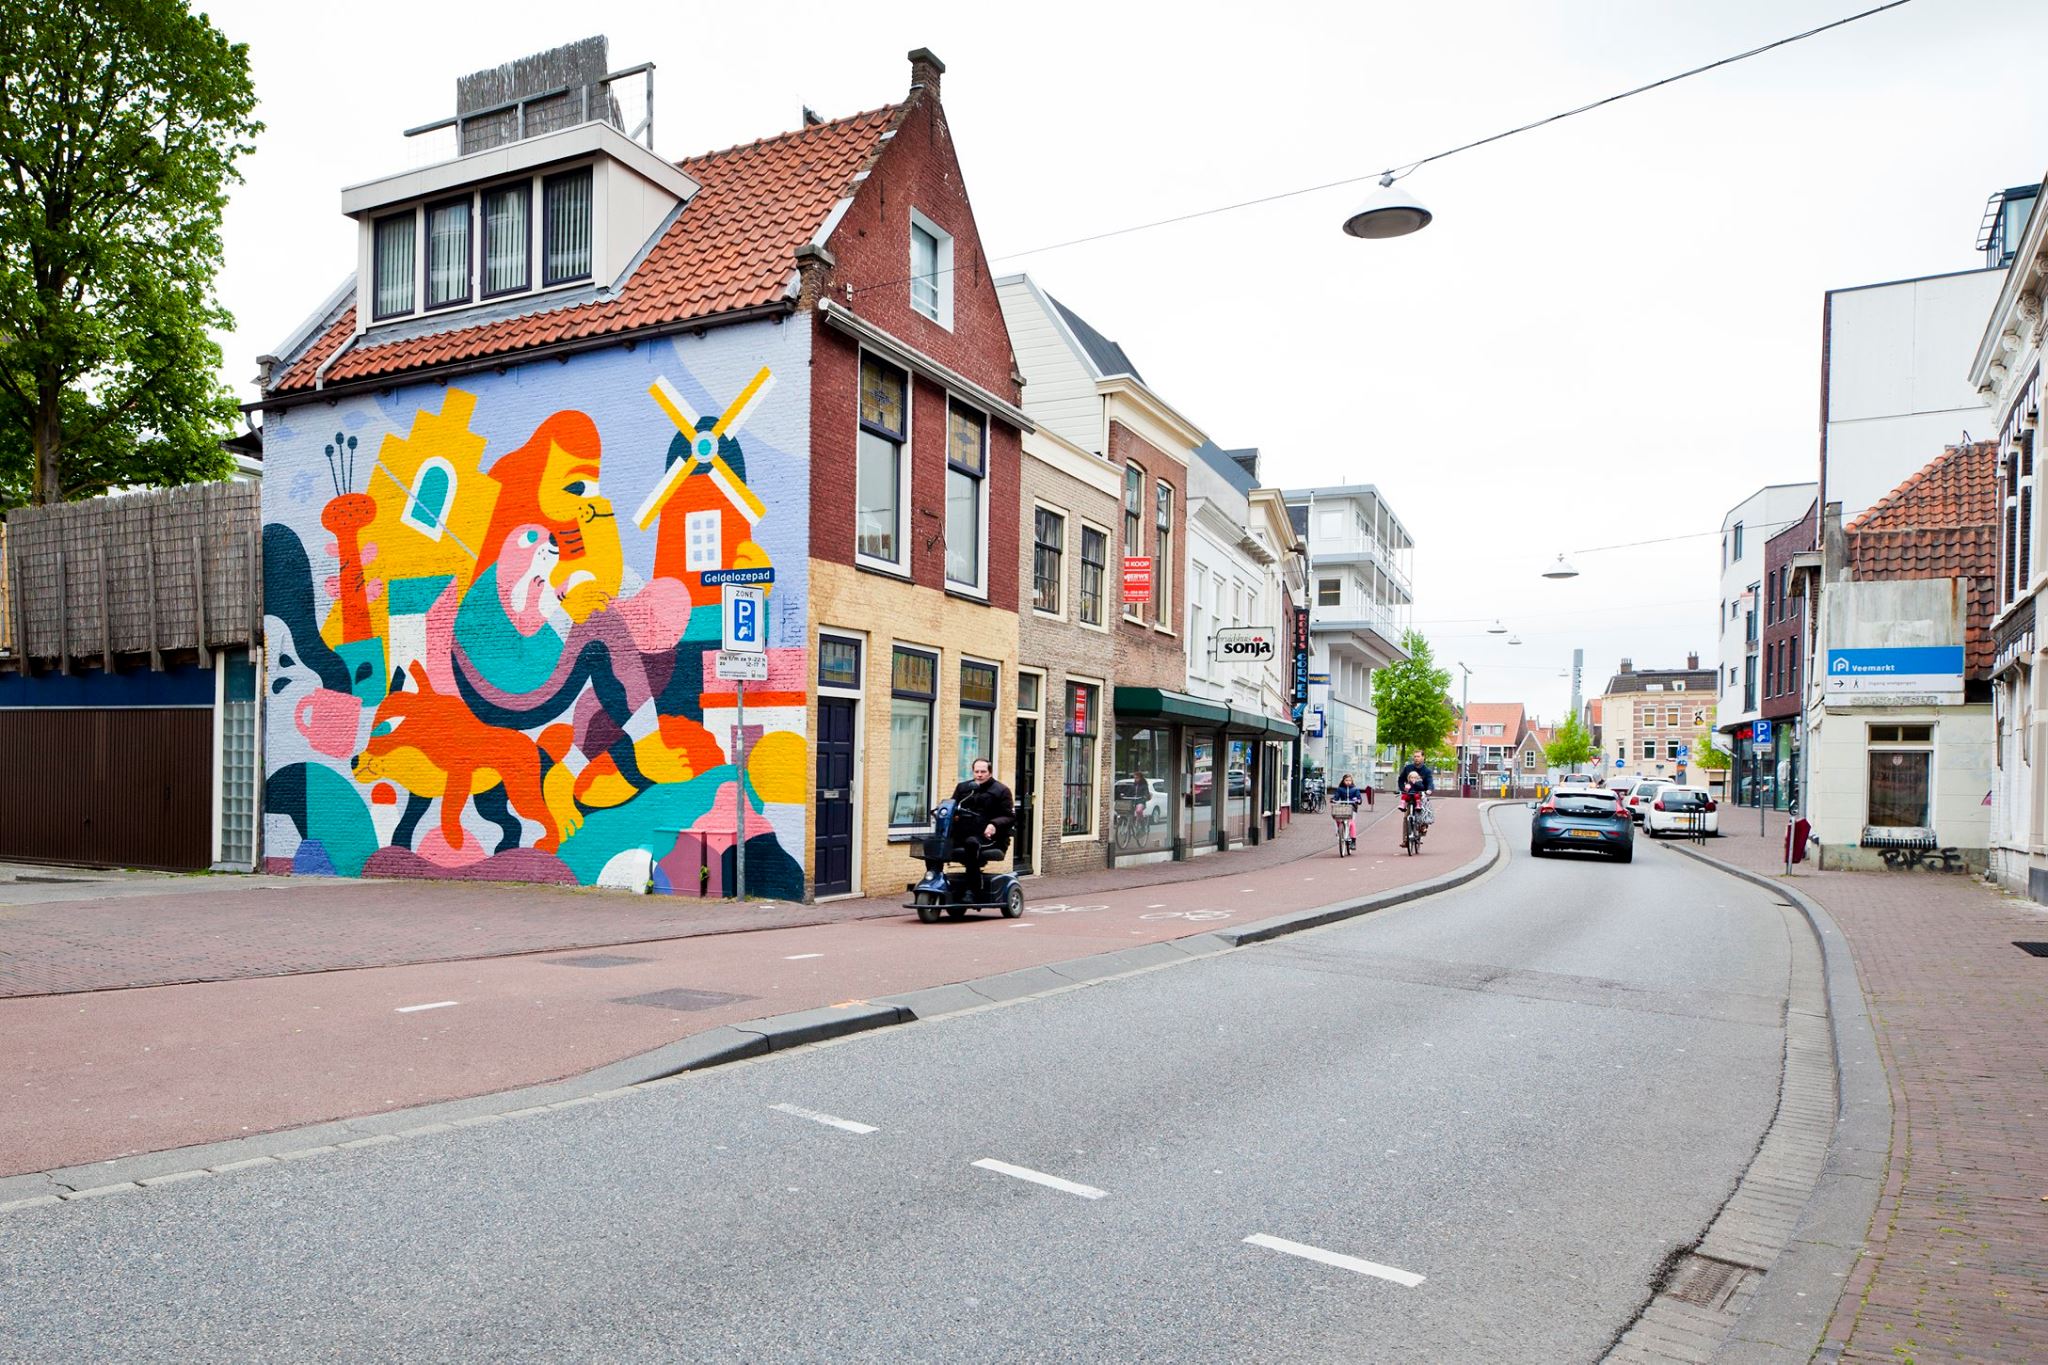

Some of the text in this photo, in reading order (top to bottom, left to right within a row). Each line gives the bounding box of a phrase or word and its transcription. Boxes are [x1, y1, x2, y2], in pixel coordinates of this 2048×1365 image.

[704, 570, 770, 582] Geldelozepad
[735, 590, 754, 598] ZONE
[738, 601, 752, 623] P
[1224, 641, 1271, 658] sonja
[1852, 664, 1895, 672] Veemarkt
[1296, 653, 1308, 699] CORNER
[1757, 723, 1768, 735] P
